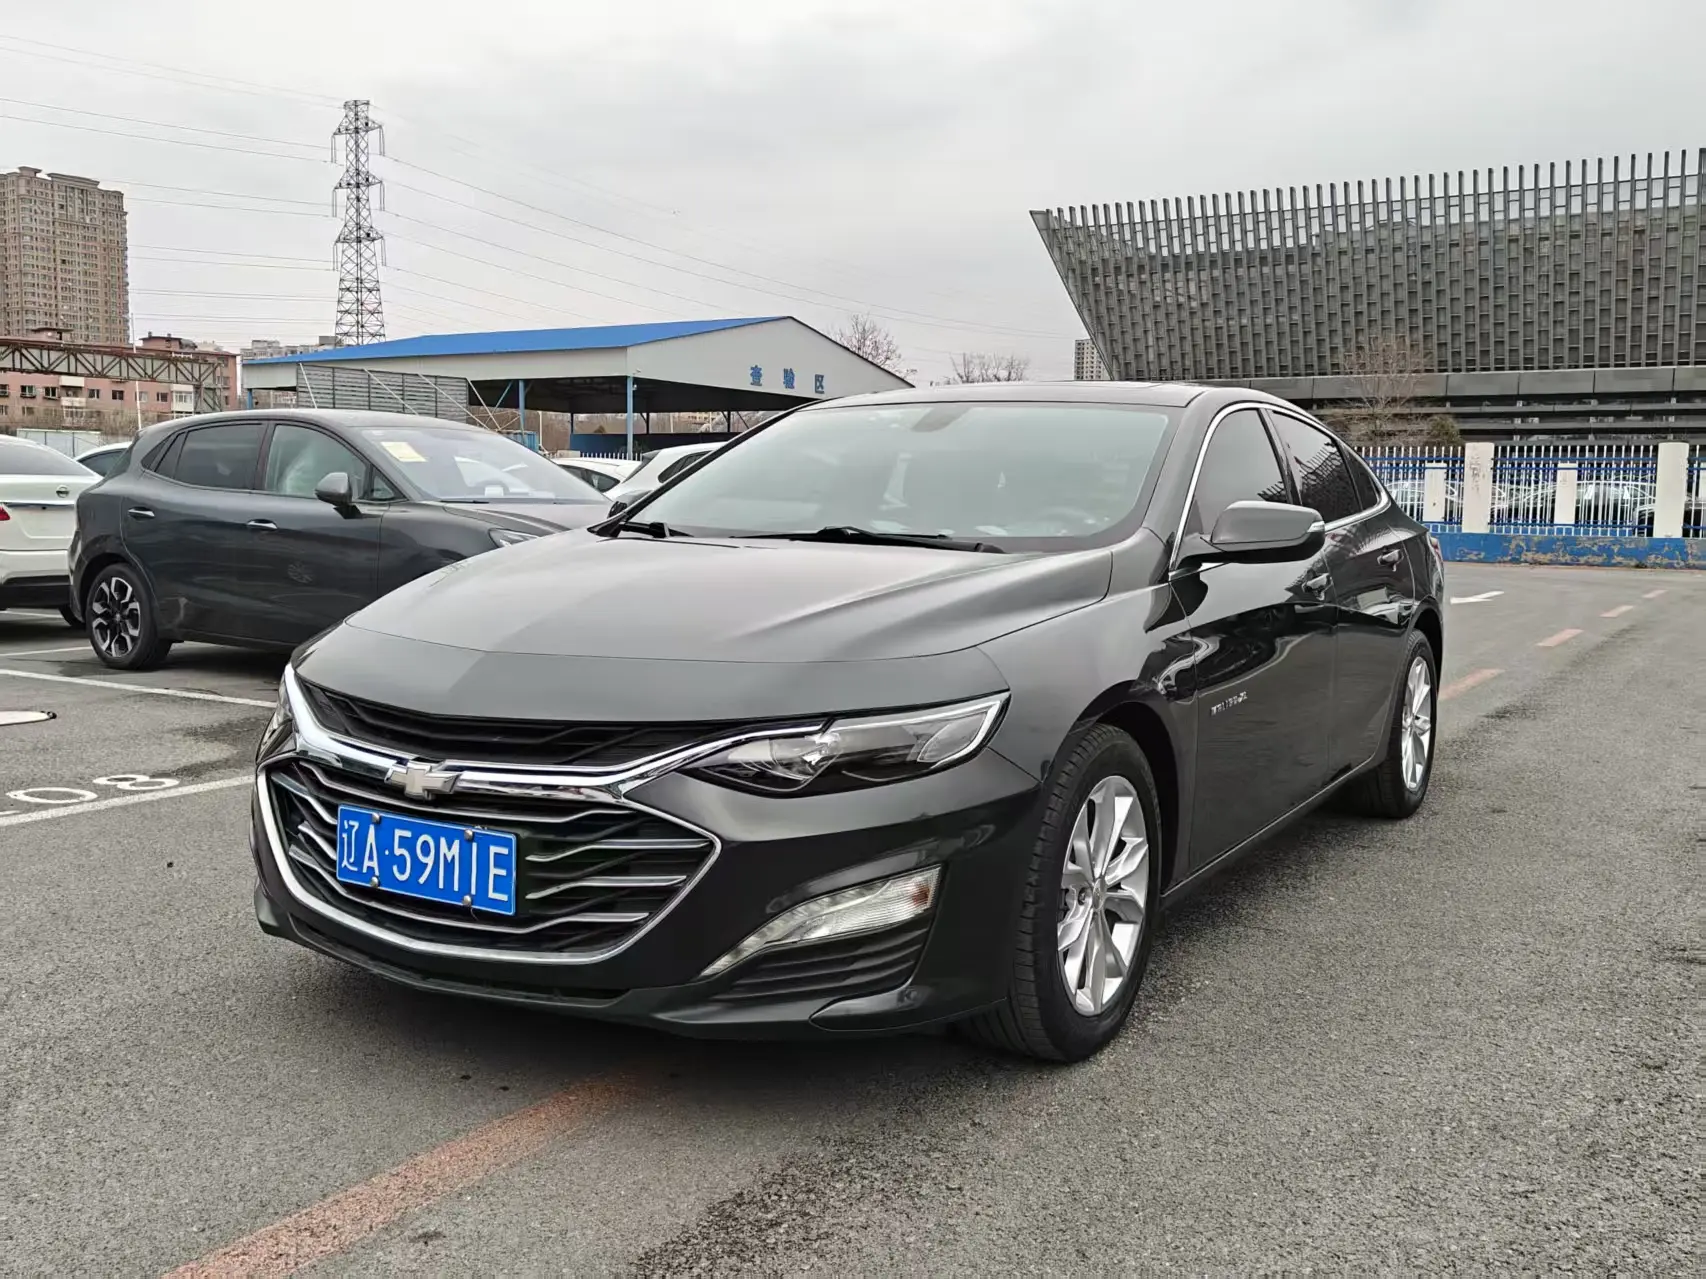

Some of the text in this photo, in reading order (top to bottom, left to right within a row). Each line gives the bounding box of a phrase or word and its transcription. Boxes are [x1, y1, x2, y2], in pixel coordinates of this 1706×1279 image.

[750, 364, 825, 394] 查验区
[0, 773, 180, 816] 08
